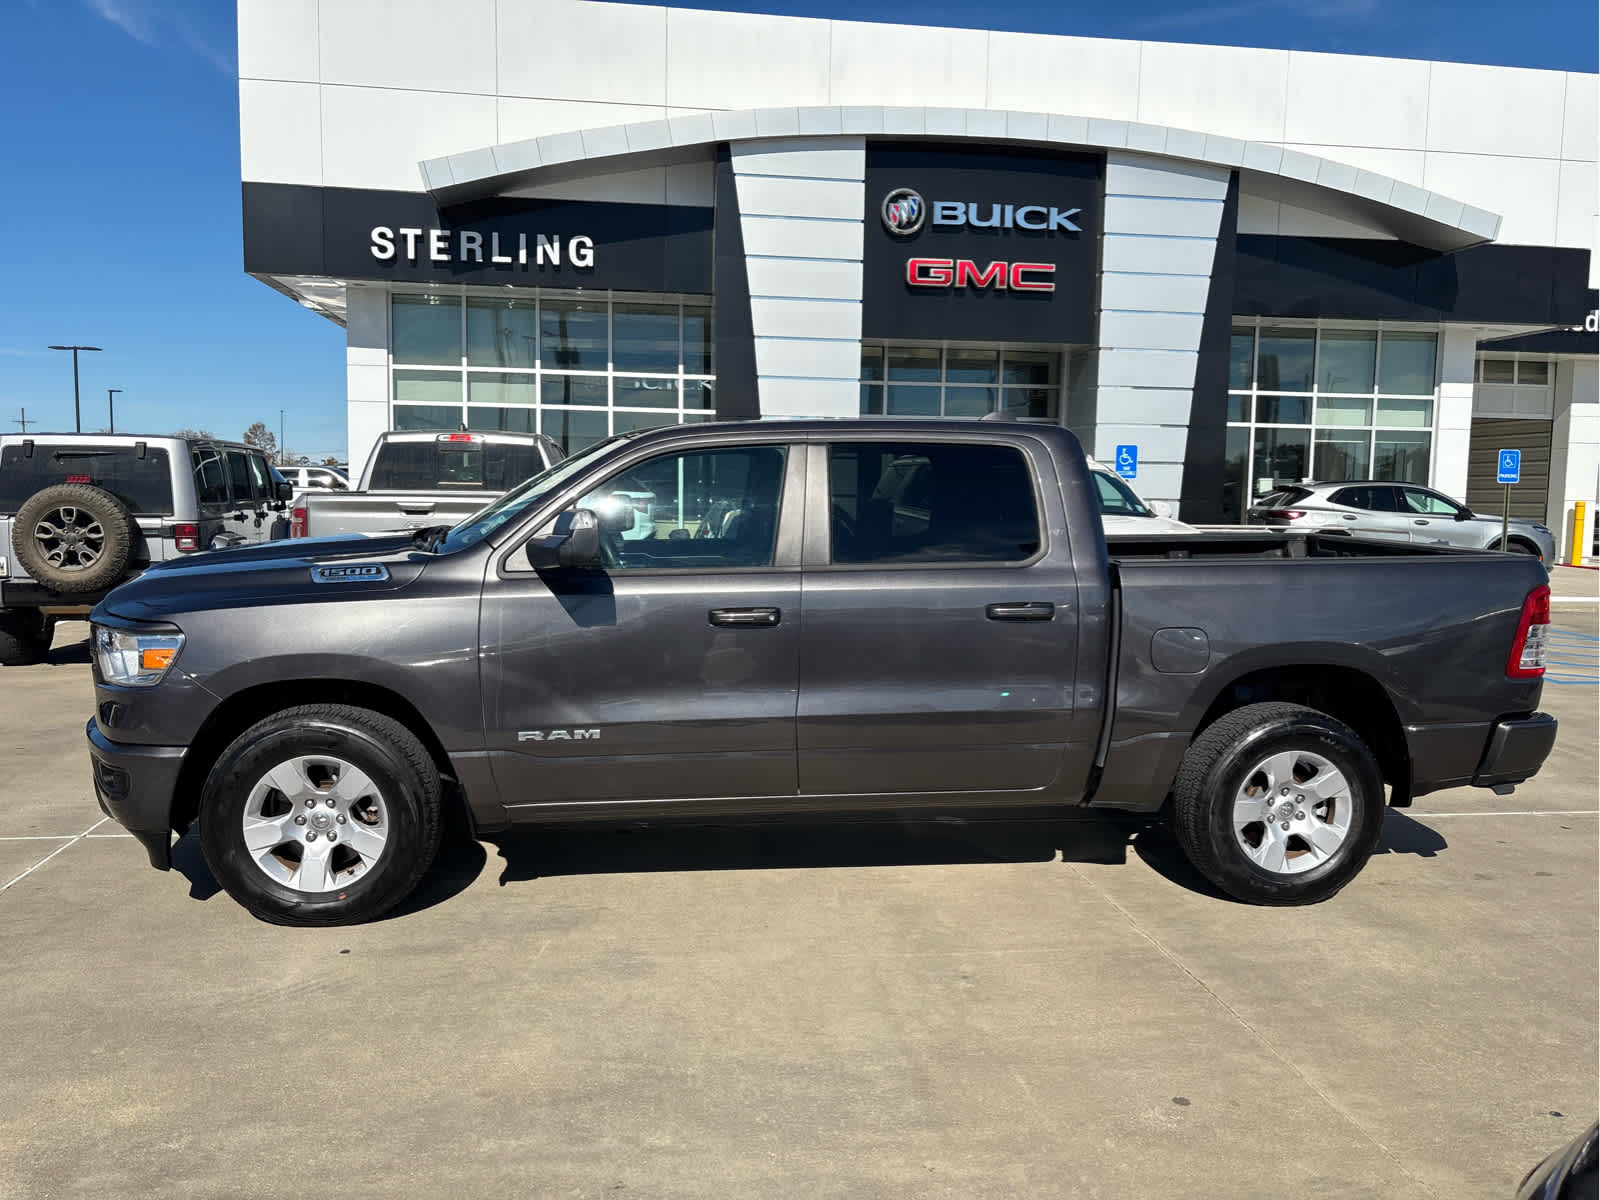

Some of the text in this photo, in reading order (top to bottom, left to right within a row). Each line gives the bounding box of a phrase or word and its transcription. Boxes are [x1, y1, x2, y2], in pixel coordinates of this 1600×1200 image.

[932, 201, 1083, 232] BUICK
[370, 226, 595, 268] STERLING
[906, 258, 1057, 293] GMC
[322, 566, 378, 577] 1500
[518, 729, 600, 741] RAM
